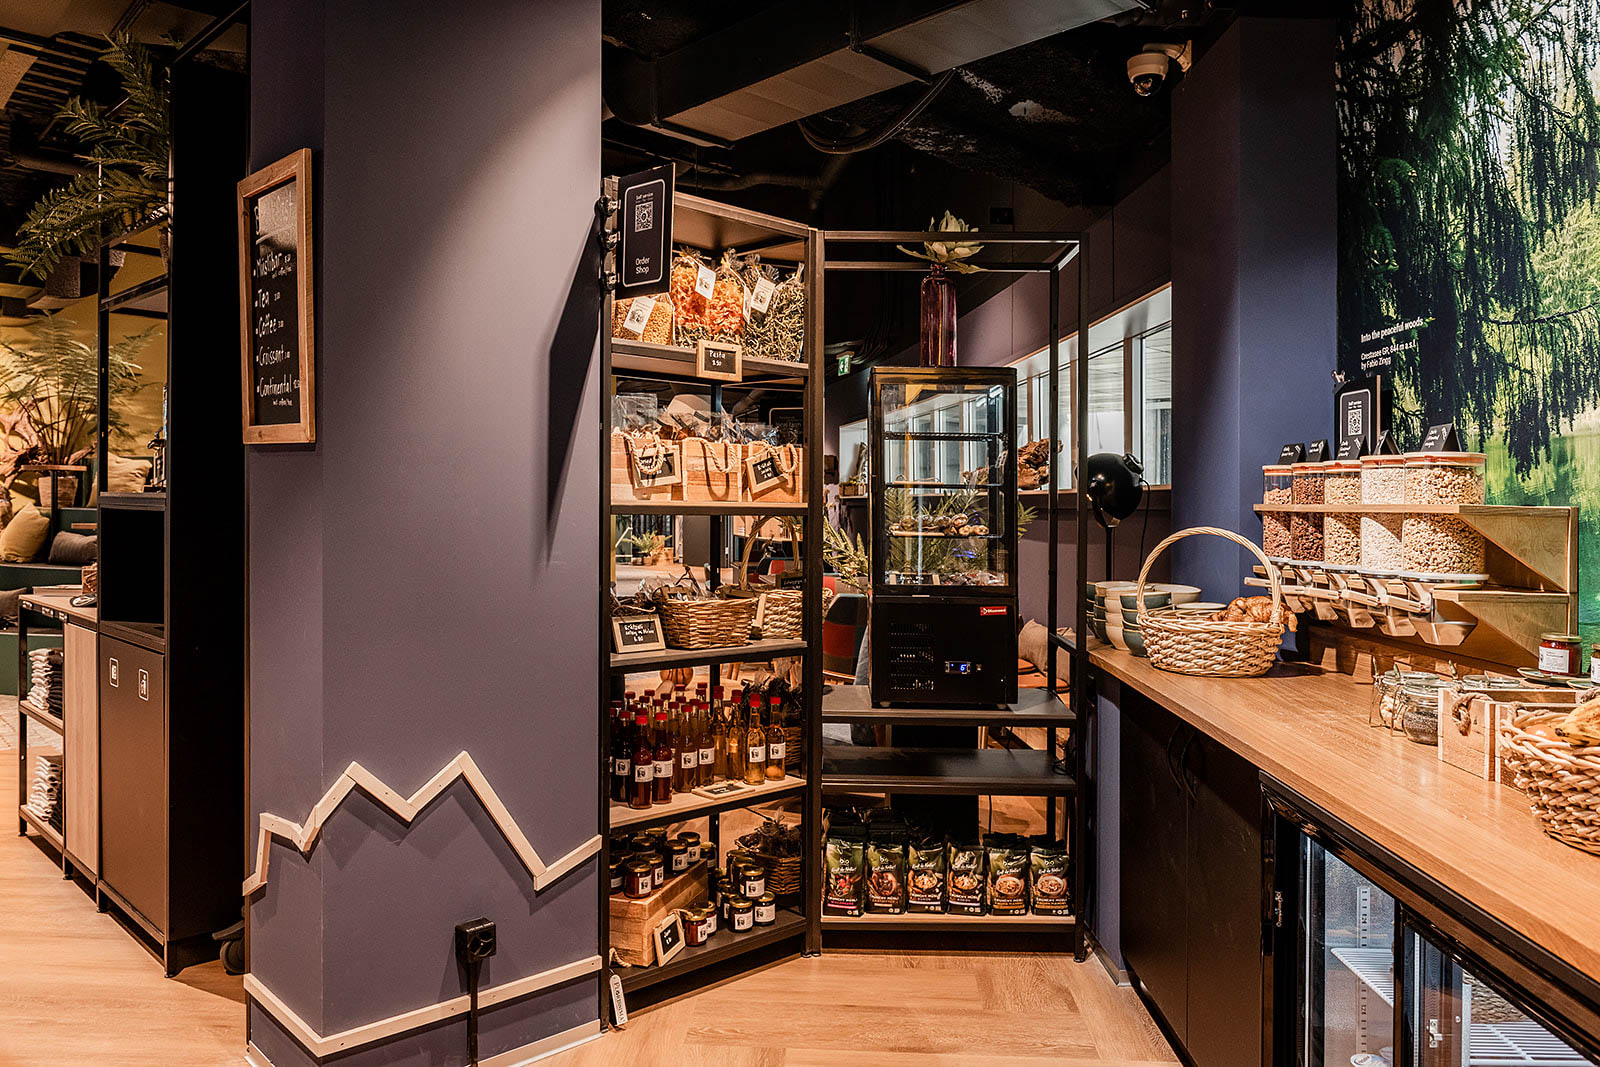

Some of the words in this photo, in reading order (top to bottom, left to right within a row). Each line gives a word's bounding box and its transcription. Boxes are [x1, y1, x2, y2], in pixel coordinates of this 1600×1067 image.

[636, 256, 650, 266] Order
[636, 266, 650, 274] Shop
[258, 289, 270, 308] Tea
[259, 313, 278, 338] Coffee
[1360, 333, 1372, 343] Into
[1372, 330, 1380, 340] the
[1380, 321, 1404, 340] peaceful
[1404, 316, 1424, 331] woods
[260, 344, 284, 366] Croissant
[710, 350, 726, 360] Pasta
[1360, 362, 1367, 371] by
[260, 374, 292, 398] Continental
